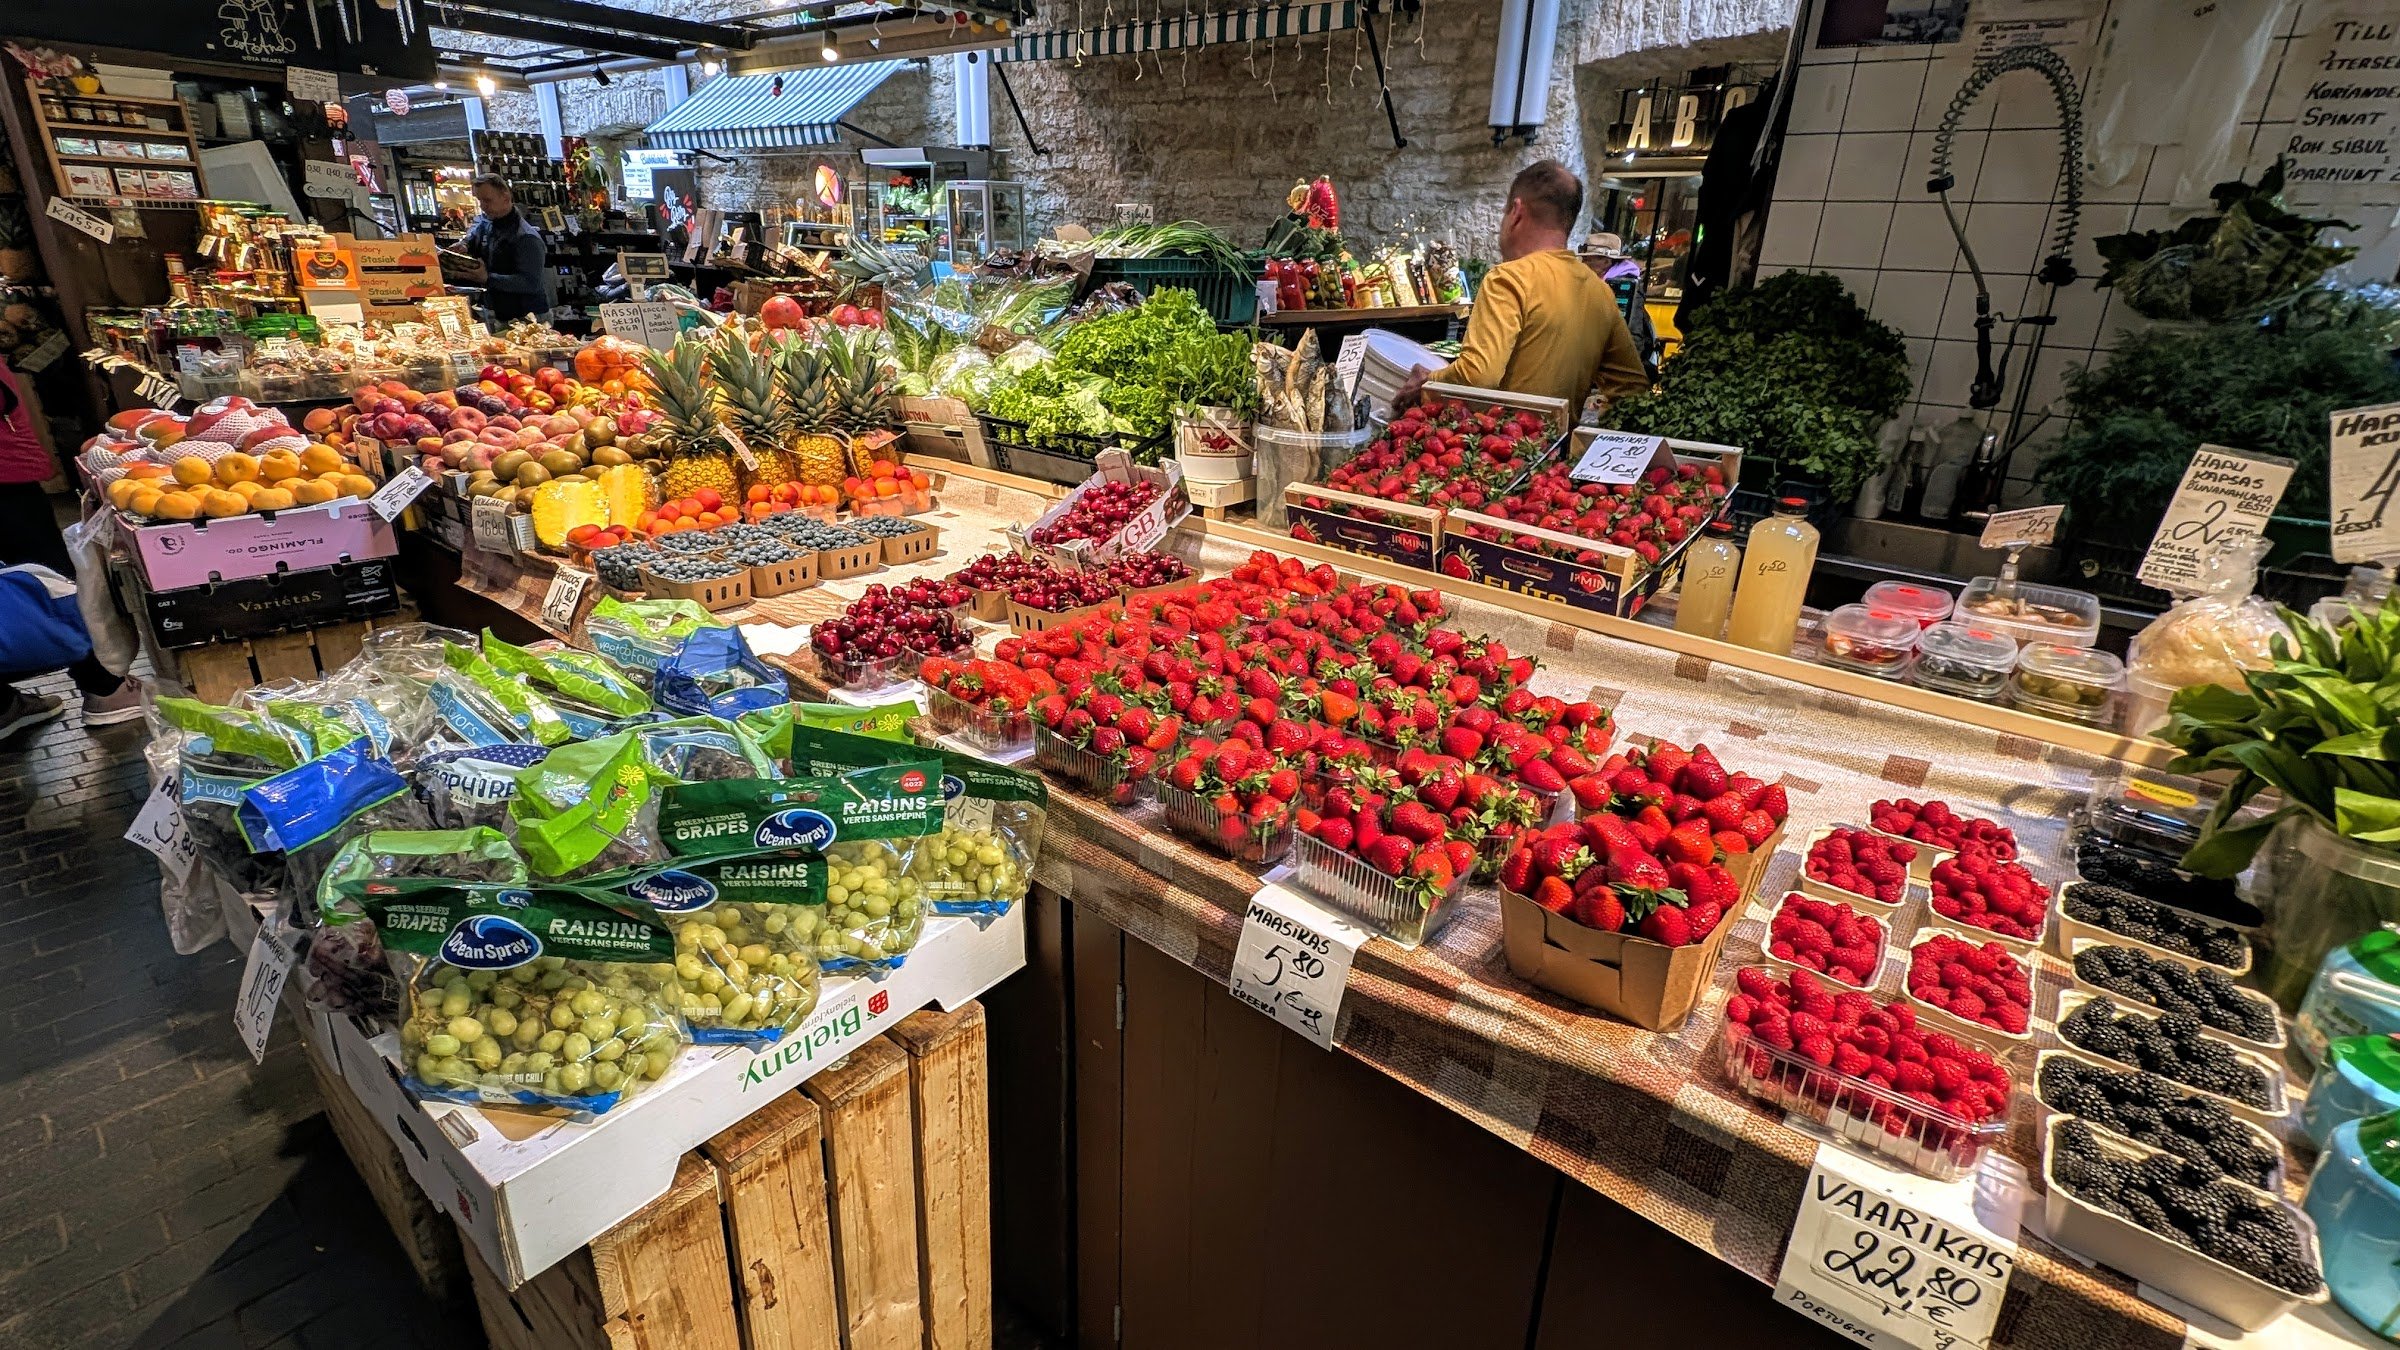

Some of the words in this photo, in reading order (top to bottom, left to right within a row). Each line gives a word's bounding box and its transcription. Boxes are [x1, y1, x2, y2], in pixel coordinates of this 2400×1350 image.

[52, 205, 105, 236] KASSA
[360, 255, 396, 264] Stasiak
[368, 287, 403, 296] Stasiak
[603, 307, 639, 318] KASSA
[611, 317, 641, 327] SELJA
[2192, 454, 2249, 473] HAPU
[2193, 470, 2265, 490] KAPSAS
[1124, 510, 1156, 547] GB
[247, 537, 324, 553] FLAMINGO
[903, 781, 924, 789] 4022
[843, 797, 927, 816] RAISINS
[674, 818, 704, 827] GREEN
[704, 812, 747, 825] SEEDLESS
[843, 814, 870, 825] VERTS
[871, 812, 894, 823] SANS
[895, 810, 927, 821] PÉPINS
[675, 820, 749, 841] GRAPES
[759, 827, 794, 846] Ocean
[719, 863, 808, 880] RAISINS
[632, 879, 673, 902] Ocean
[673, 883, 708, 904] Spray
[721, 880, 751, 888] VERTS
[750, 880, 775, 888] SANS
[775, 879, 808, 888] PÉPINS
[414, 905, 450, 915] SEEDLESS
[386, 914, 448, 934] GRAPES
[550, 918, 651, 941] RAISINS
[448, 930, 484, 960] Ocean
[486, 938, 533, 961] Spray
[550, 936, 584, 947] VERTS
[584, 938, 612, 948] SANS
[613, 938, 650, 951] PÉPINS
[742, 1005, 862, 1093] Bielany
[525, 1072, 544, 1083] CHILI
[1789, 1290, 1876, 1344] PORTUGAL
